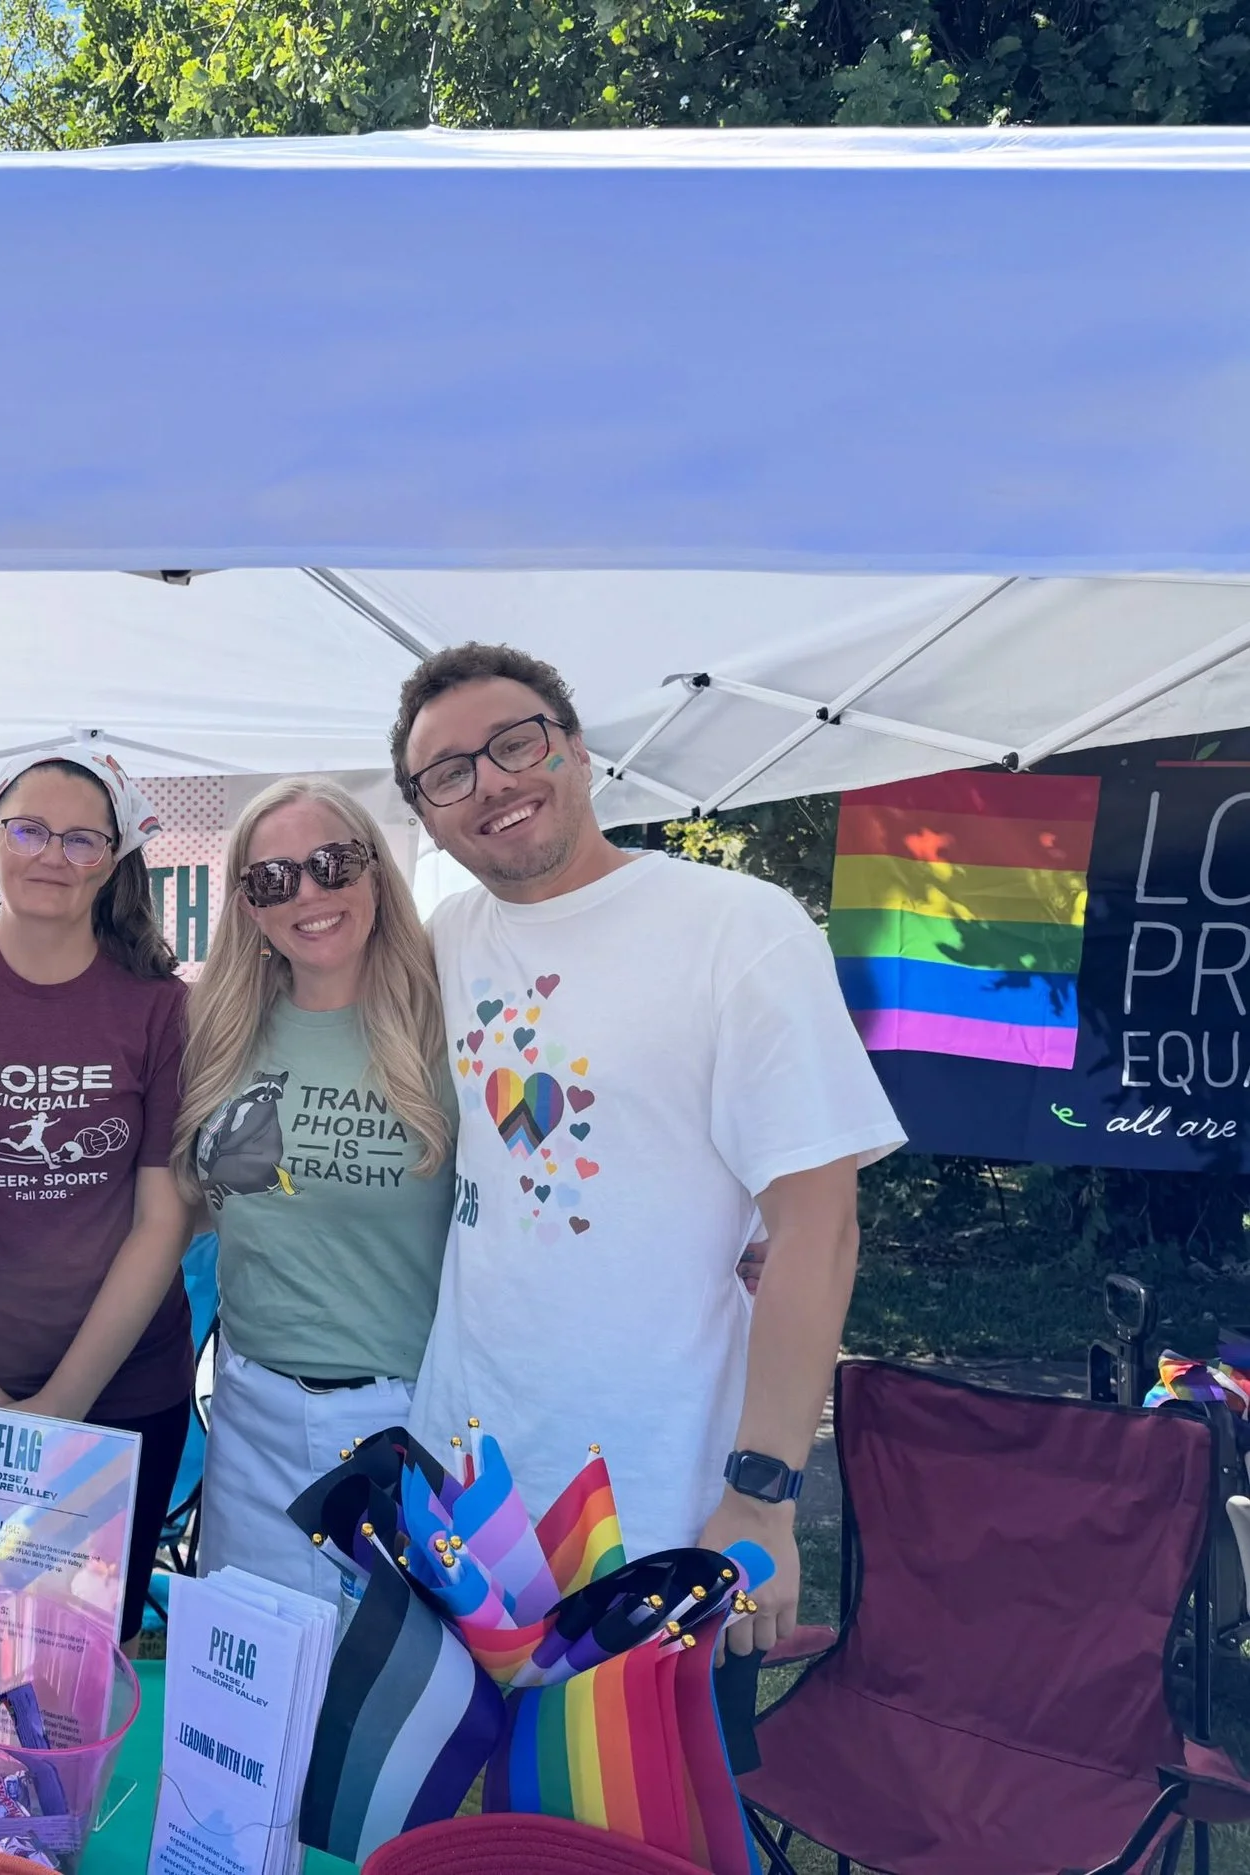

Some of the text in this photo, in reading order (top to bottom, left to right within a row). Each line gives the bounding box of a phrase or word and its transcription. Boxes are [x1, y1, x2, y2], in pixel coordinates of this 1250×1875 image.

[151, 865, 209, 963] TH
[1122, 1030, 1250, 1095] EQU
[301, 1085, 388, 1115] TRAN
[291, 1114, 407, 1143] PHOBIA
[1106, 1105, 1237, 1139] all are
[334, 1139, 359, 1160] IS
[44, 1172, 108, 1187] SPORTS
[287, 1157, 405, 1188] TRASHY
[15, 1190, 67, 1201] Fall 2026
[16, 1485, 58, 1501] VALLEY
[208, 1626, 258, 1681] PFLAG
[191, 1665, 270, 1708] TREASURE VALLEY
[213, 1668, 241, 1688] BOISE
[179, 1722, 214, 1760] LEADING
[216, 1740, 240, 1774] WITH
[168, 1822, 186, 1837] PFLAG
[186, 1832, 192, 1840] is
[192, 1835, 201, 1846] the
[225, 1856, 245, 1872] largest
[170, 1836, 204, 1860] organization
